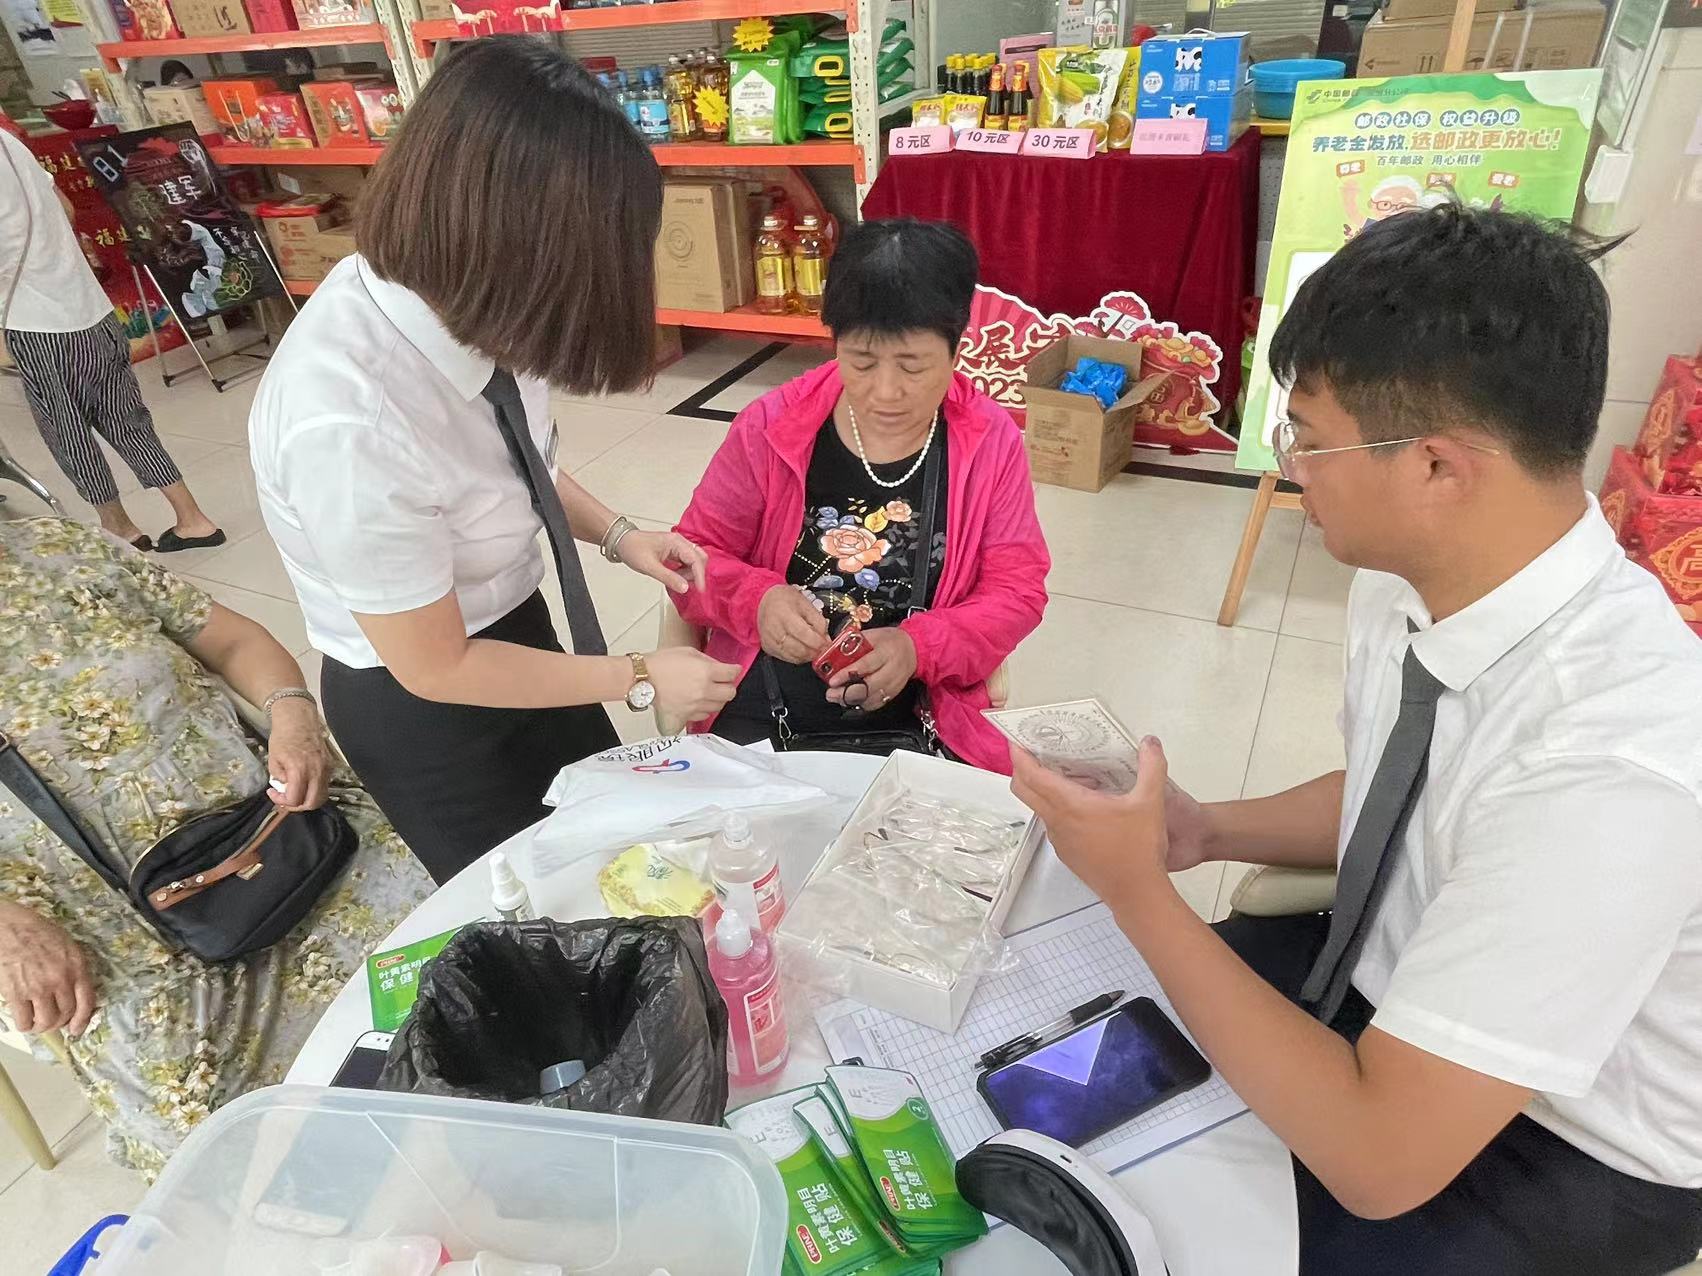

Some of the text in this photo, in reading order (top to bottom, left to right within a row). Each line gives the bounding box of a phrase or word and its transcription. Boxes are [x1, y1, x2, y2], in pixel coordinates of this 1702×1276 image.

[1356, 109, 1519, 128] 邮政社保 权益升级
[895, 135, 931, 149] 8 元区
[967, 131, 1010, 144] 10 元区
[1032, 135, 1080, 149] 30 元区
[1377, 154, 1482, 166] 百年邮政 用心相伴
[797, 1187, 840, 1254] 叶黄素明目
